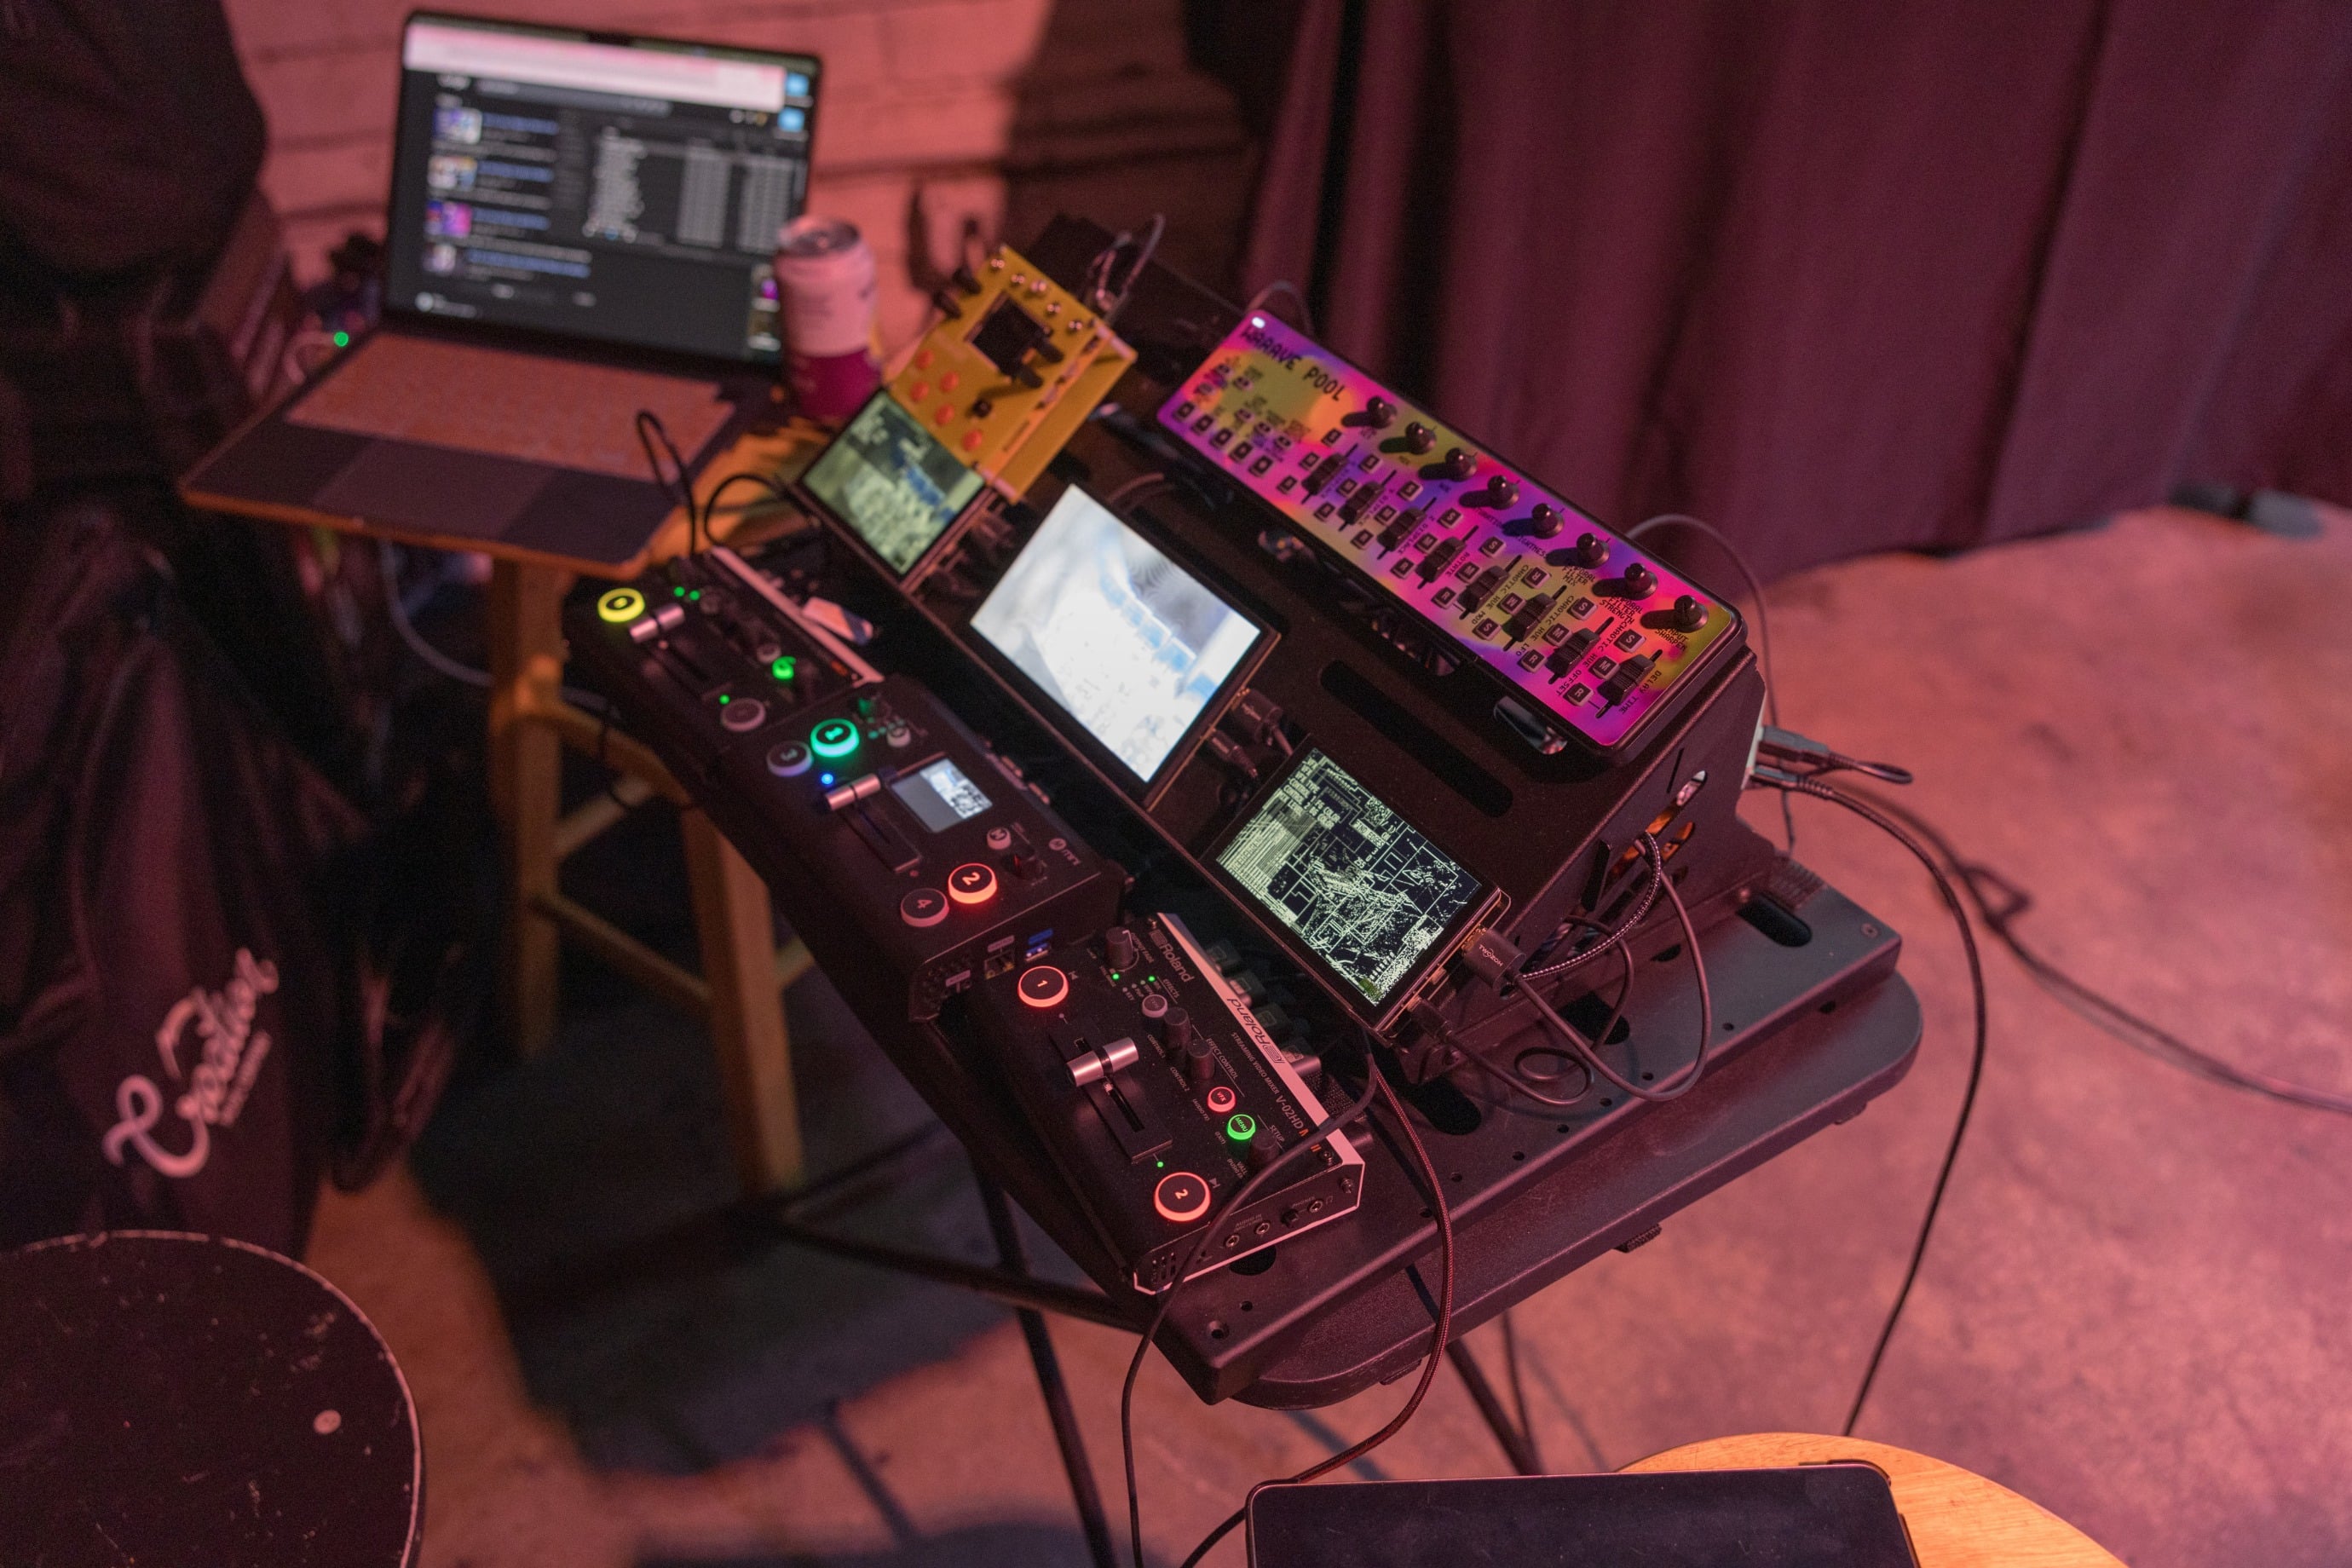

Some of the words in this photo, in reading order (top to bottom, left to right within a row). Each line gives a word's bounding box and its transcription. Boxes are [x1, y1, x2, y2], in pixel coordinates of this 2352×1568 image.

[1302, 365, 1346, 402] POOL
[1445, 551, 1469, 577] ROTATE
[1500, 563, 1529, 594] CHAOTIC
[1561, 565, 1588, 585] FILTER
[1563, 575, 1576, 586] MIX
[1485, 596, 1499, 608] HUE
[1544, 594, 1574, 625] CHAOTIC
[1599, 598, 1634, 625] STRENGTH
[1608, 597, 1635, 617] FILTER
[1471, 611, 1484, 624] MOD
[1530, 626, 1543, 639] HUE
[1597, 620, 1627, 651] CHAOTIC
[1654, 627, 1686, 651] SHARPEN
[1515, 643, 1528, 655] LFO
[1582, 653, 1595, 666] HUE
[1555, 668, 1581, 695] OFFSET
[1638, 669, 1662, 694] DELAY
[1618, 695, 1637, 714] TIME
[1366, 831, 1384, 847] EDGES
[1354, 857, 1365, 868] 255
[1159, 943, 1194, 983] Roland
[1226, 997, 1270, 1046] Roland
[1169, 1066, 1186, 1087] CONTROL
[1218, 1055, 1237, 1080] CONTROL
[1231, 1031, 1255, 1062] STREAMING
[1252, 1061, 1266, 1077] VIDEO
[1264, 1077, 1279, 1094] MIXER
[1274, 1095, 1304, 1130] V-02HD
[1217, 1092, 1225, 1101] VFX
[1234, 1117, 1248, 1133] MENU
[1269, 1125, 1284, 1142] SETUP
